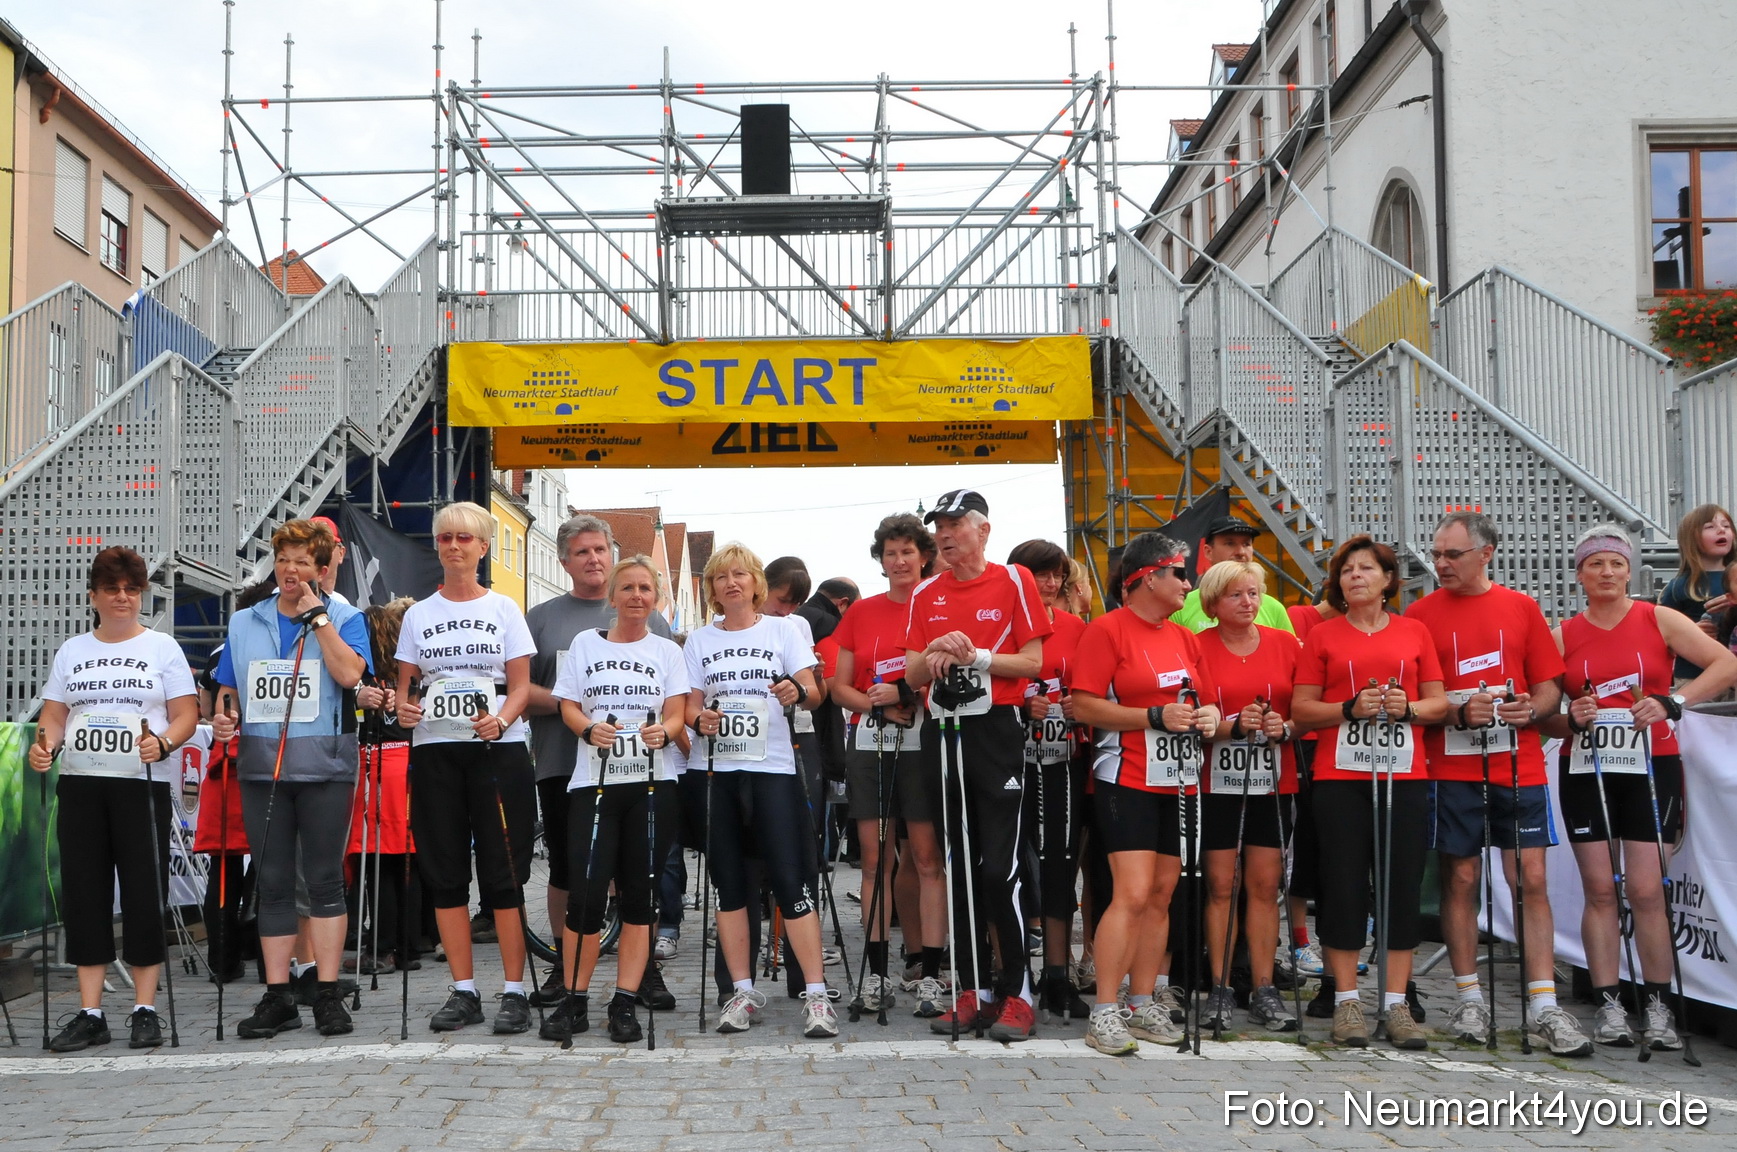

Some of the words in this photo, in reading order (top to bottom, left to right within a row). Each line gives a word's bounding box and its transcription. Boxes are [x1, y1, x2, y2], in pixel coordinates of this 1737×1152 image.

[656, 357, 877, 407] START
[918, 382, 993, 395] Neumarkter
[996, 382, 1056, 395] Stadtlauf
[483, 386, 557, 398] Neumarkter
[560, 385, 619, 398] Stadtlauf
[520, 435, 588, 446] Neumarkter
[589, 435, 642, 446] Stadtlauf
[908, 431, 975, 444] Neumarkter
[977, 430, 1029, 441] Stadtlauf
[423, 619, 498, 640] BERGER
[419, 645, 462, 659] POWER
[465, 643, 501, 655] GIRLS
[702, 648, 774, 668] BERGER
[1471, 658, 1488, 668] DEHN
[73, 657, 148, 675] BERGER
[455, 663, 469, 671] and
[470, 663, 493, 672] talking
[585, 660, 656, 679] BERGER
[886, 660, 904, 670] DEHN
[65, 680, 107, 693] POWER
[112, 678, 154, 690] GIRLS
[255, 676, 311, 699] 8065
[624, 685, 661, 696] GIRLS
[1608, 680, 1627, 691] DEHN
[744, 688, 768, 698] talking
[116, 697, 143, 708] talking
[262, 703, 284, 714] Maria
[627, 703, 652, 711] talkin
[718, 714, 759, 737] 063
[74, 728, 133, 753] 8090
[872, 733, 904, 744] Sbine
[1347, 720, 1405, 748] 8036
[1470, 733, 1498, 746] Joef
[1580, 725, 1643, 750] 8007
[717, 742, 747, 753] Christl
[1026, 747, 1060, 759] Brgitte
[1220, 747, 1273, 771] 8019
[1354, 751, 1397, 764] Meane
[1584, 754, 1636, 766] Mrianne
[608, 763, 646, 775] Brigitte
[1167, 766, 1195, 777] Briitte
